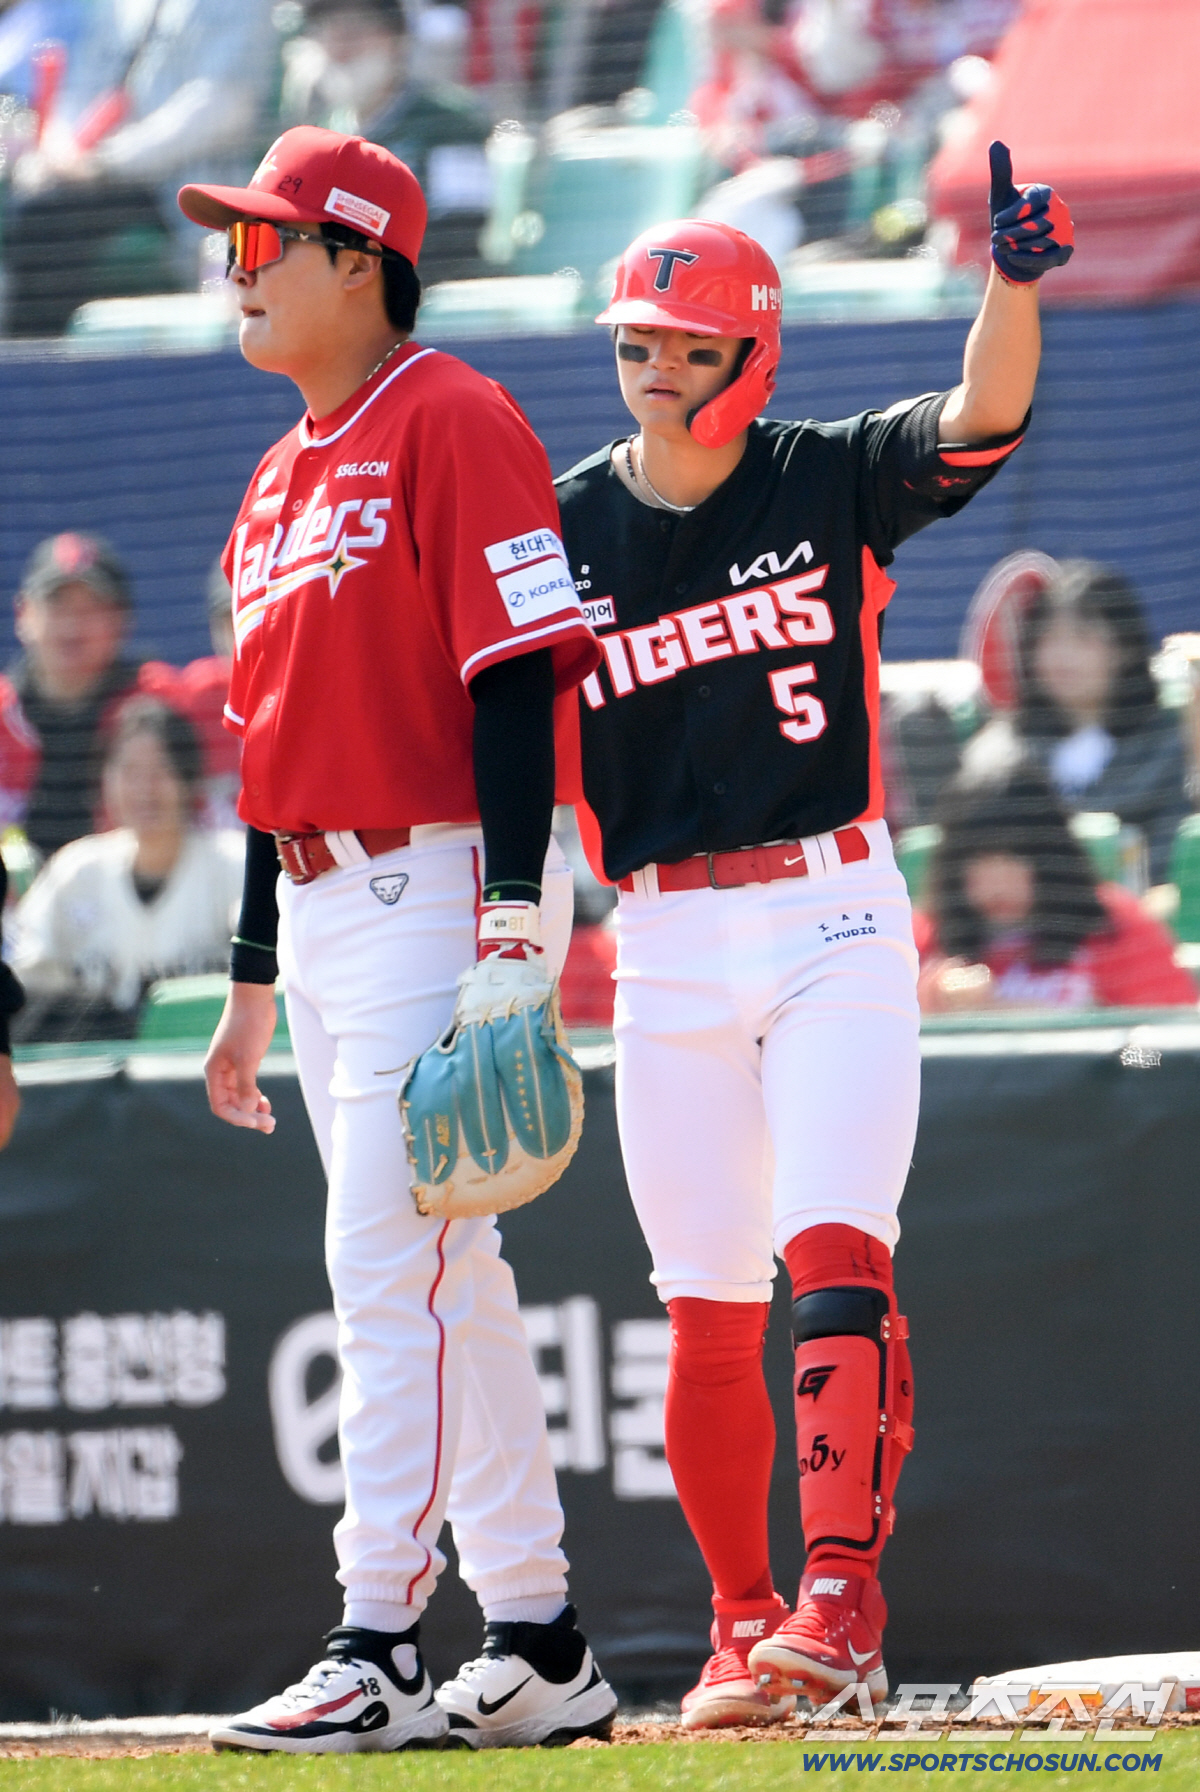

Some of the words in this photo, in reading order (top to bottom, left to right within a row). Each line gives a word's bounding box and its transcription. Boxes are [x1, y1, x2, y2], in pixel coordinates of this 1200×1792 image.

[277, 175, 303, 195] 29
[648, 248, 700, 293] T
[334, 460, 390, 479] SSG.COM
[767, 661, 828, 744] 5
[824, 926, 877, 943] STUDIO
[809, 1578, 847, 1596] NIKE
[732, 1618, 766, 1638] NIKE
[355, 1677, 381, 1697] 18
